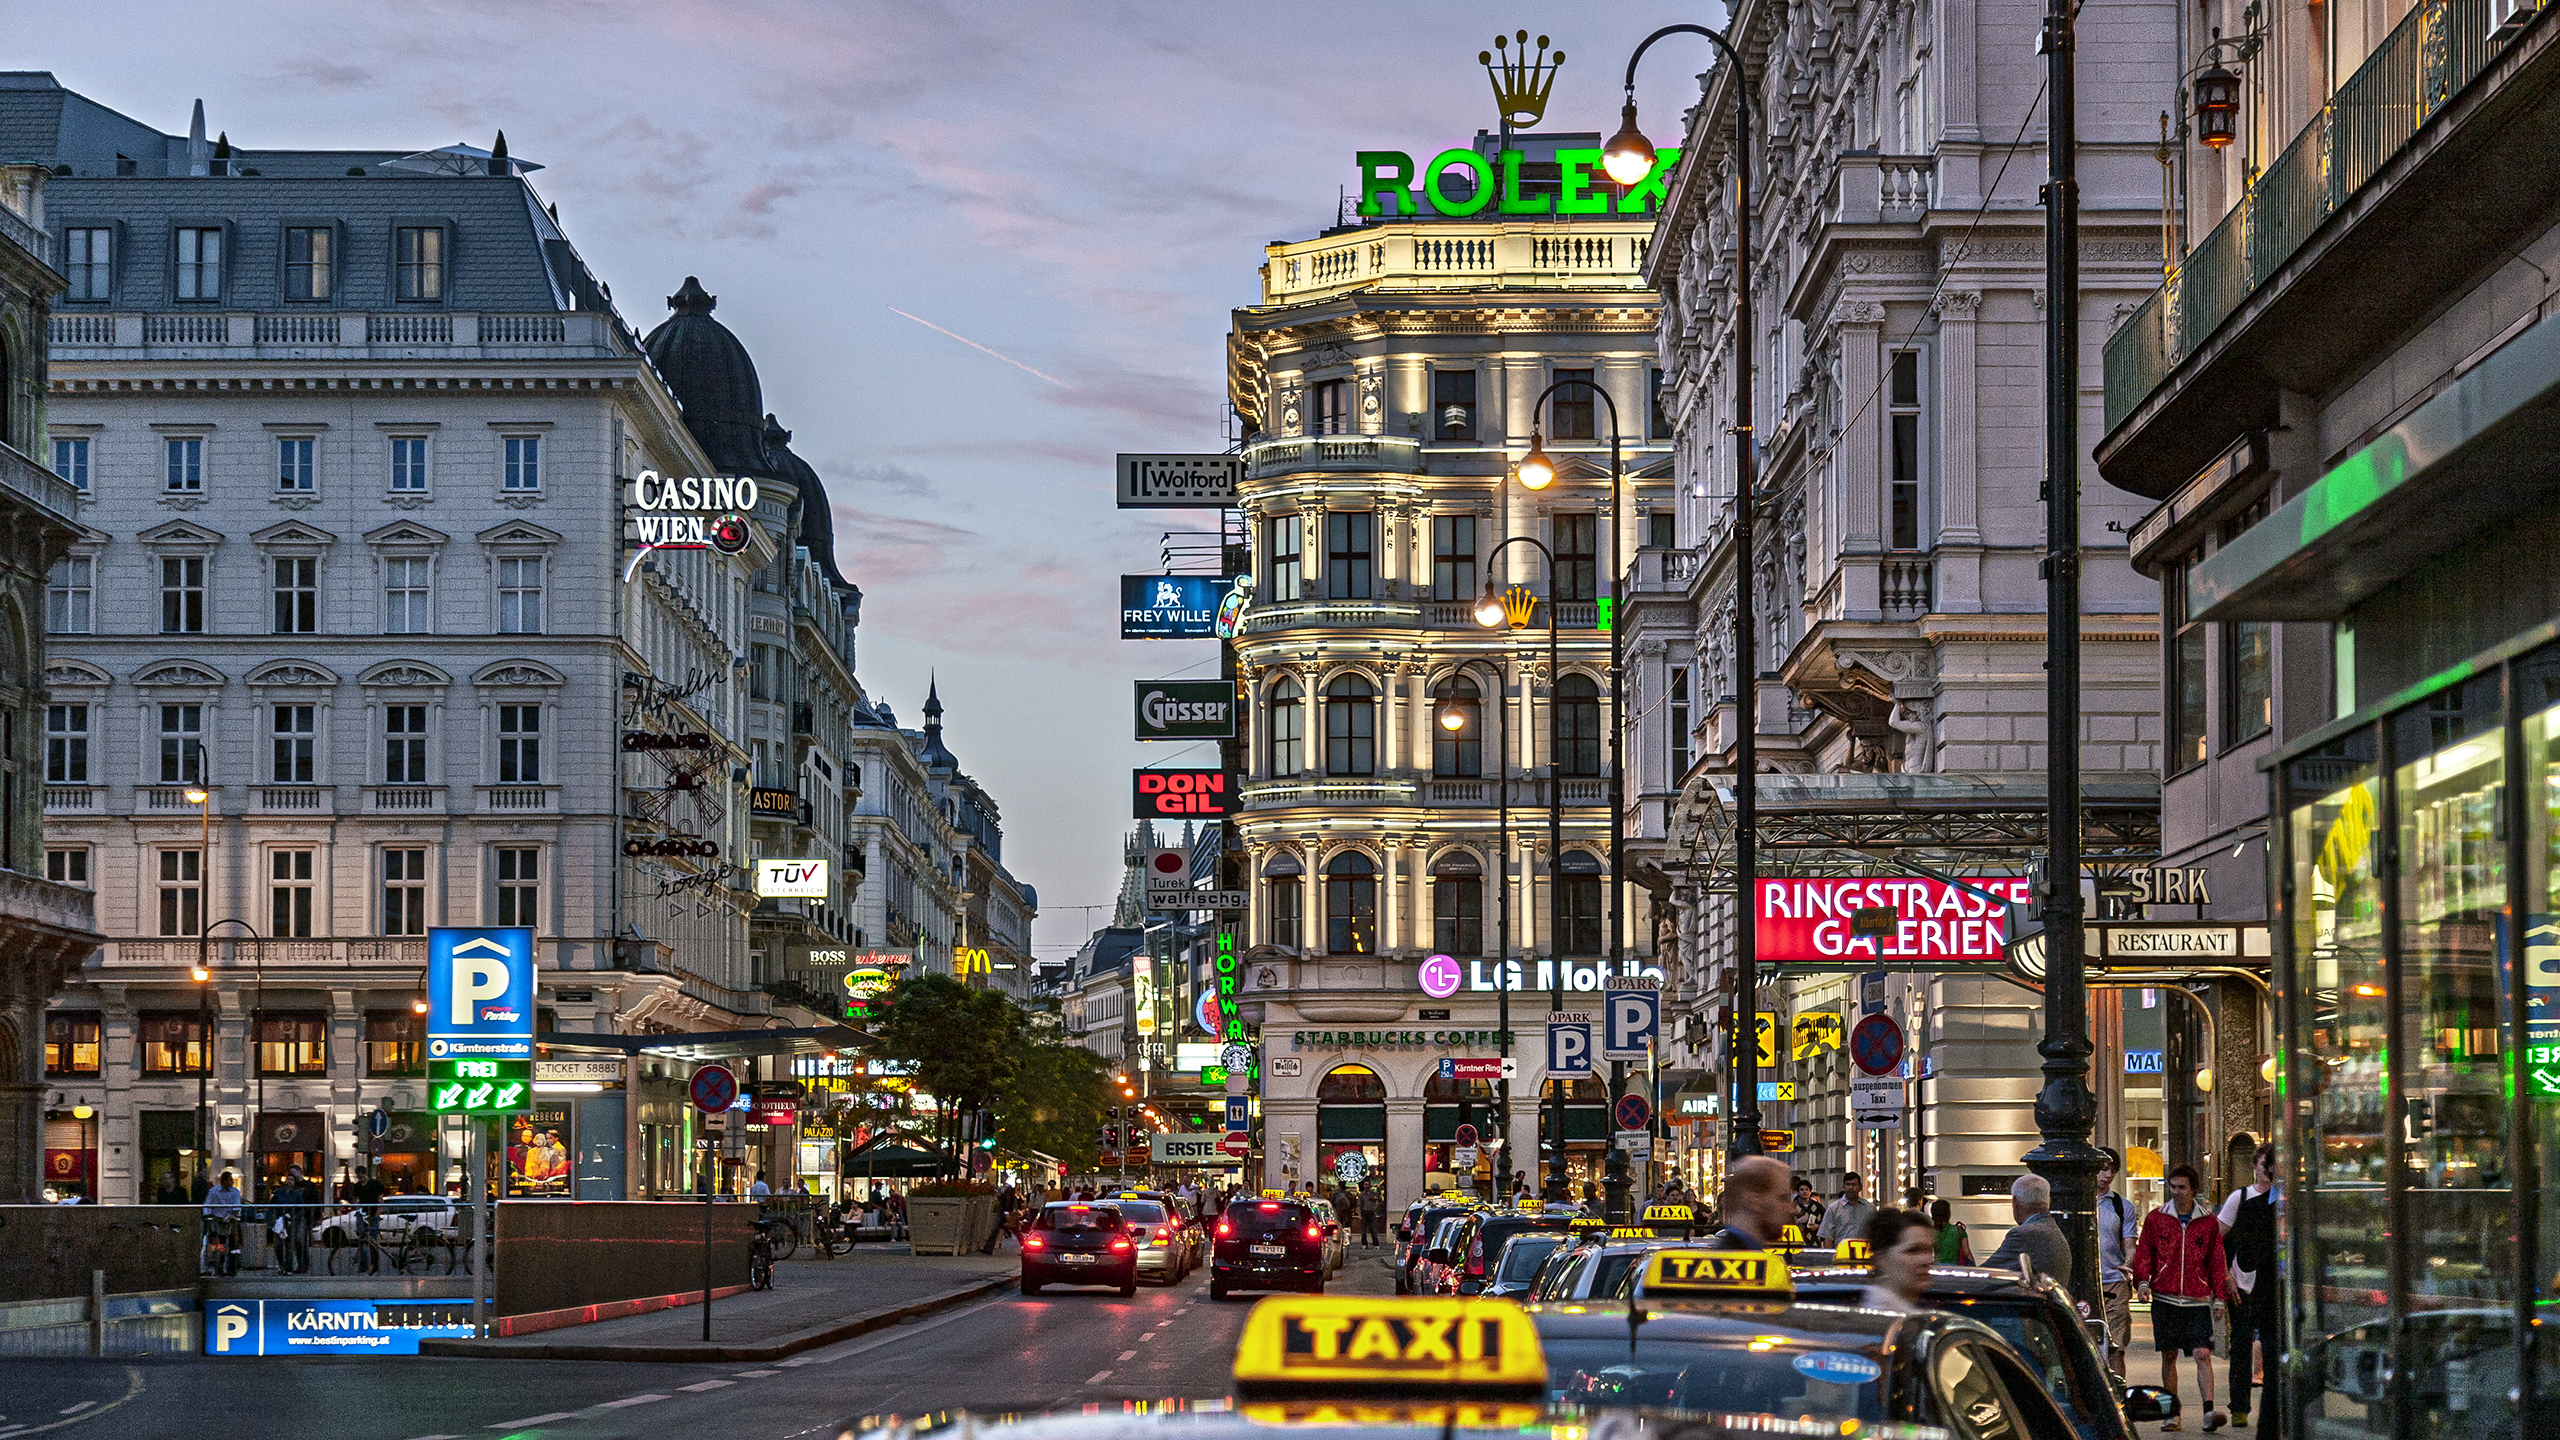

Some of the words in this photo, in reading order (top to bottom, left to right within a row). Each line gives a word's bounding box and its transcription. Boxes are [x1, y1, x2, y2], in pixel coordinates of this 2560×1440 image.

[1356, 148, 1682, 218] ROLEX
[1151, 470, 1228, 488] Wolford
[635, 469, 758, 511] CASINO
[635, 516, 704, 543] WIEN
[1124, 609, 1163, 622] FREY
[1166, 609, 1211, 622] WILLE
[1142, 690, 1229, 731] Gösser
[1139, 774, 1224, 793] DON
[752, 791, 797, 811] ASTORIA
[1155, 793, 1224, 813] GIL
[770, 863, 819, 883] TÜV
[1150, 877, 1186, 889] Turek
[2131, 867, 2212, 905] SIRK
[1764, 882, 2030, 919] RINGSTRASSE
[2117, 933, 2229, 951] RESTAURANT
[809, 950, 846, 962] BOSS
[1470, 960, 1523, 991] LG
[1605, 976, 1659, 990] ÖPARK
[451, 957, 510, 1025] P
[1548, 1012, 1590, 1023] ÖPARK
[1615, 1000, 1652, 1047] P
[1295, 1031, 1426, 1046] STARBUCKS
[450, 1043, 530, 1053] Kärntnerstraße
[1555, 1031, 1586, 1069] P
[457, 1061, 498, 1077] FREI
[586, 1063, 617, 1074] 58885
[1454, 1064, 1484, 1073] Kärntner
[1485, 1064, 1501, 1074] Ring
[1853, 1082, 1903, 1091] ausgenommen
[1870, 1093, 1886, 1104] Taxi
[804, 1127, 834, 1137] PALAZZO
[1166, 1142, 1213, 1156] ERSTE
[1652, 1207, 1688, 1218] TAXI
[1618, 1228, 1647, 1237] TAXI
[1671, 1258, 1757, 1280] TAXI
[216, 1314, 248, 1352] P
[288, 1336, 390, 1346] www.bestinparking.at
[1300, 1317, 1484, 1361] TAXI
